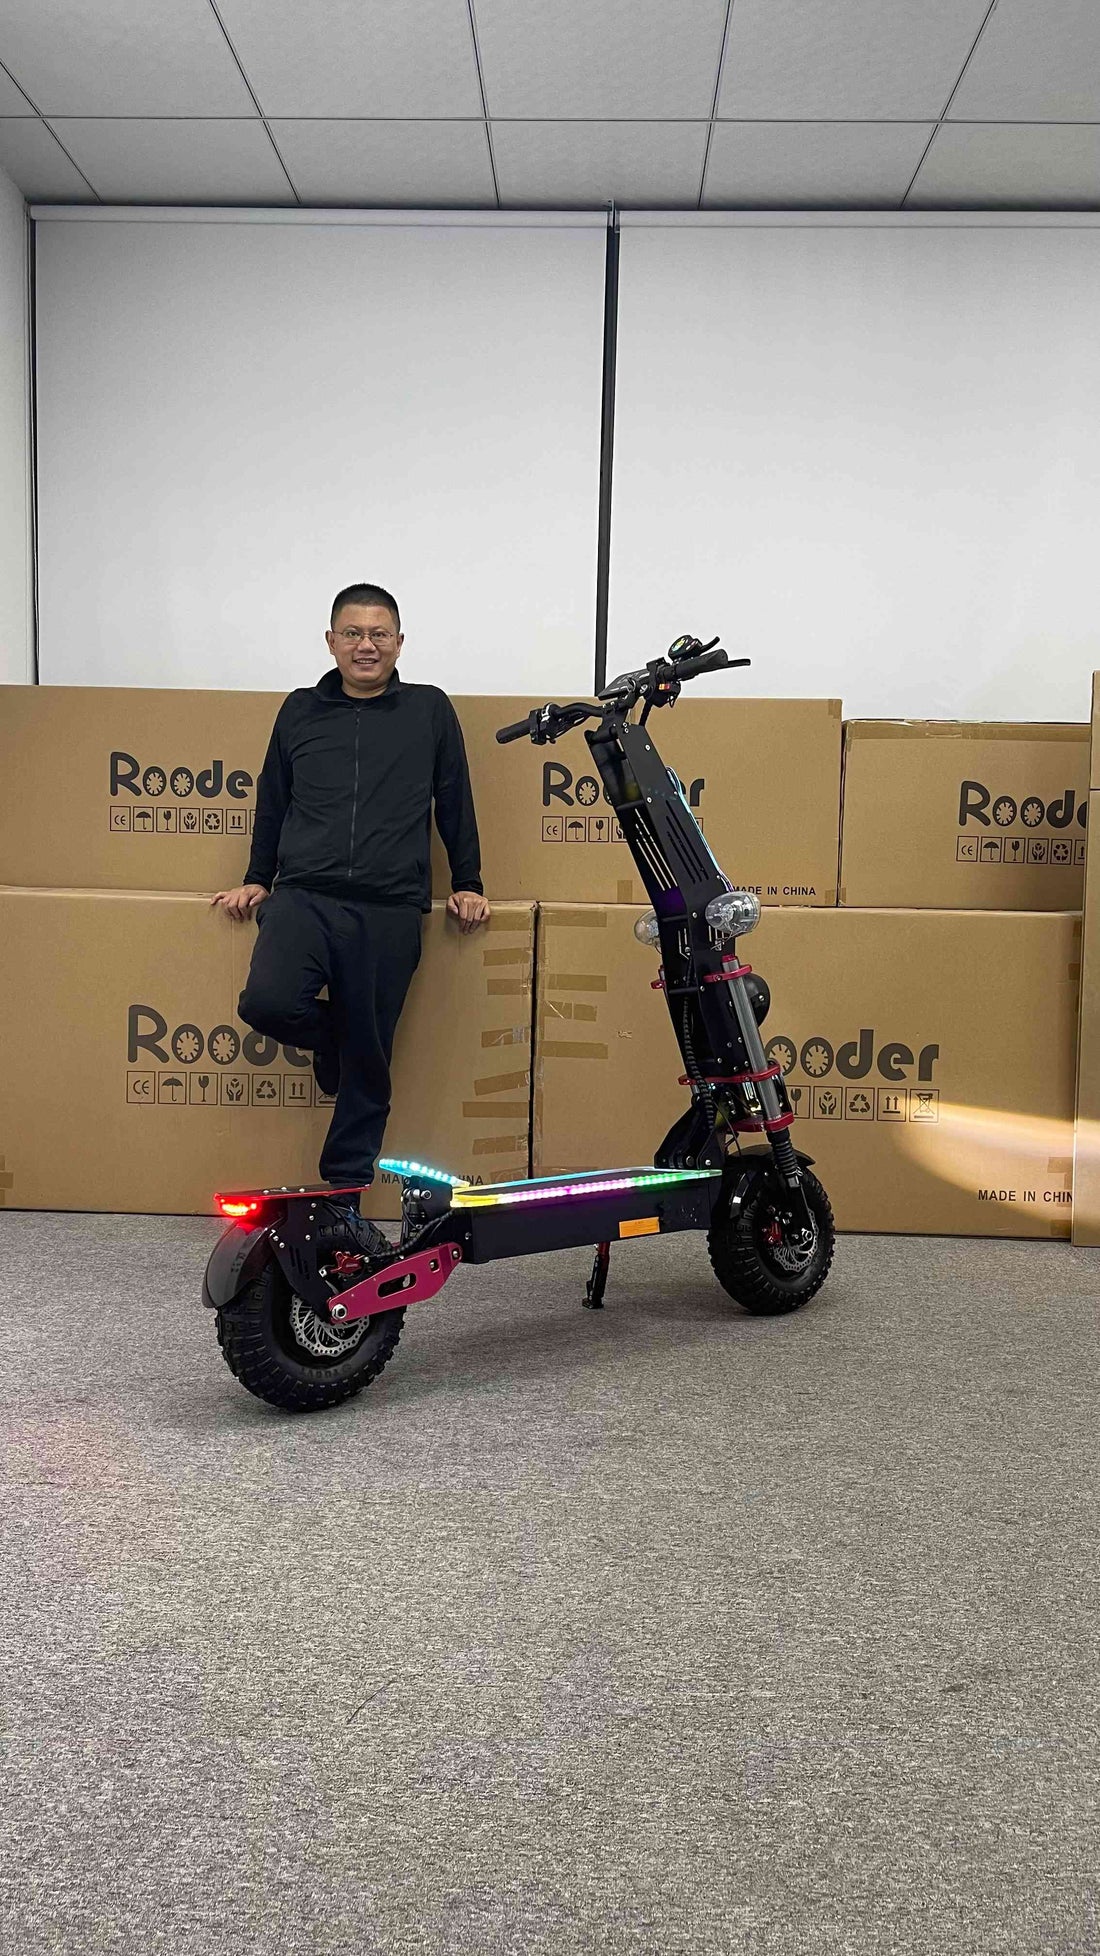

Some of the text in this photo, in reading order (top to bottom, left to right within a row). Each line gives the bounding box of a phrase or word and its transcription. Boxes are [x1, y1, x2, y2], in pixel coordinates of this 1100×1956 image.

[110, 751, 253, 799] Roode
[543, 761, 705, 807] Ror
[958, 780, 1087, 829] Rood
[767, 886, 778, 895] IN
[783, 886, 816, 896] CHINA
[764, 1028, 940, 1082] ooder
[978, 1189, 1073, 1203] MADE IN CHIN
